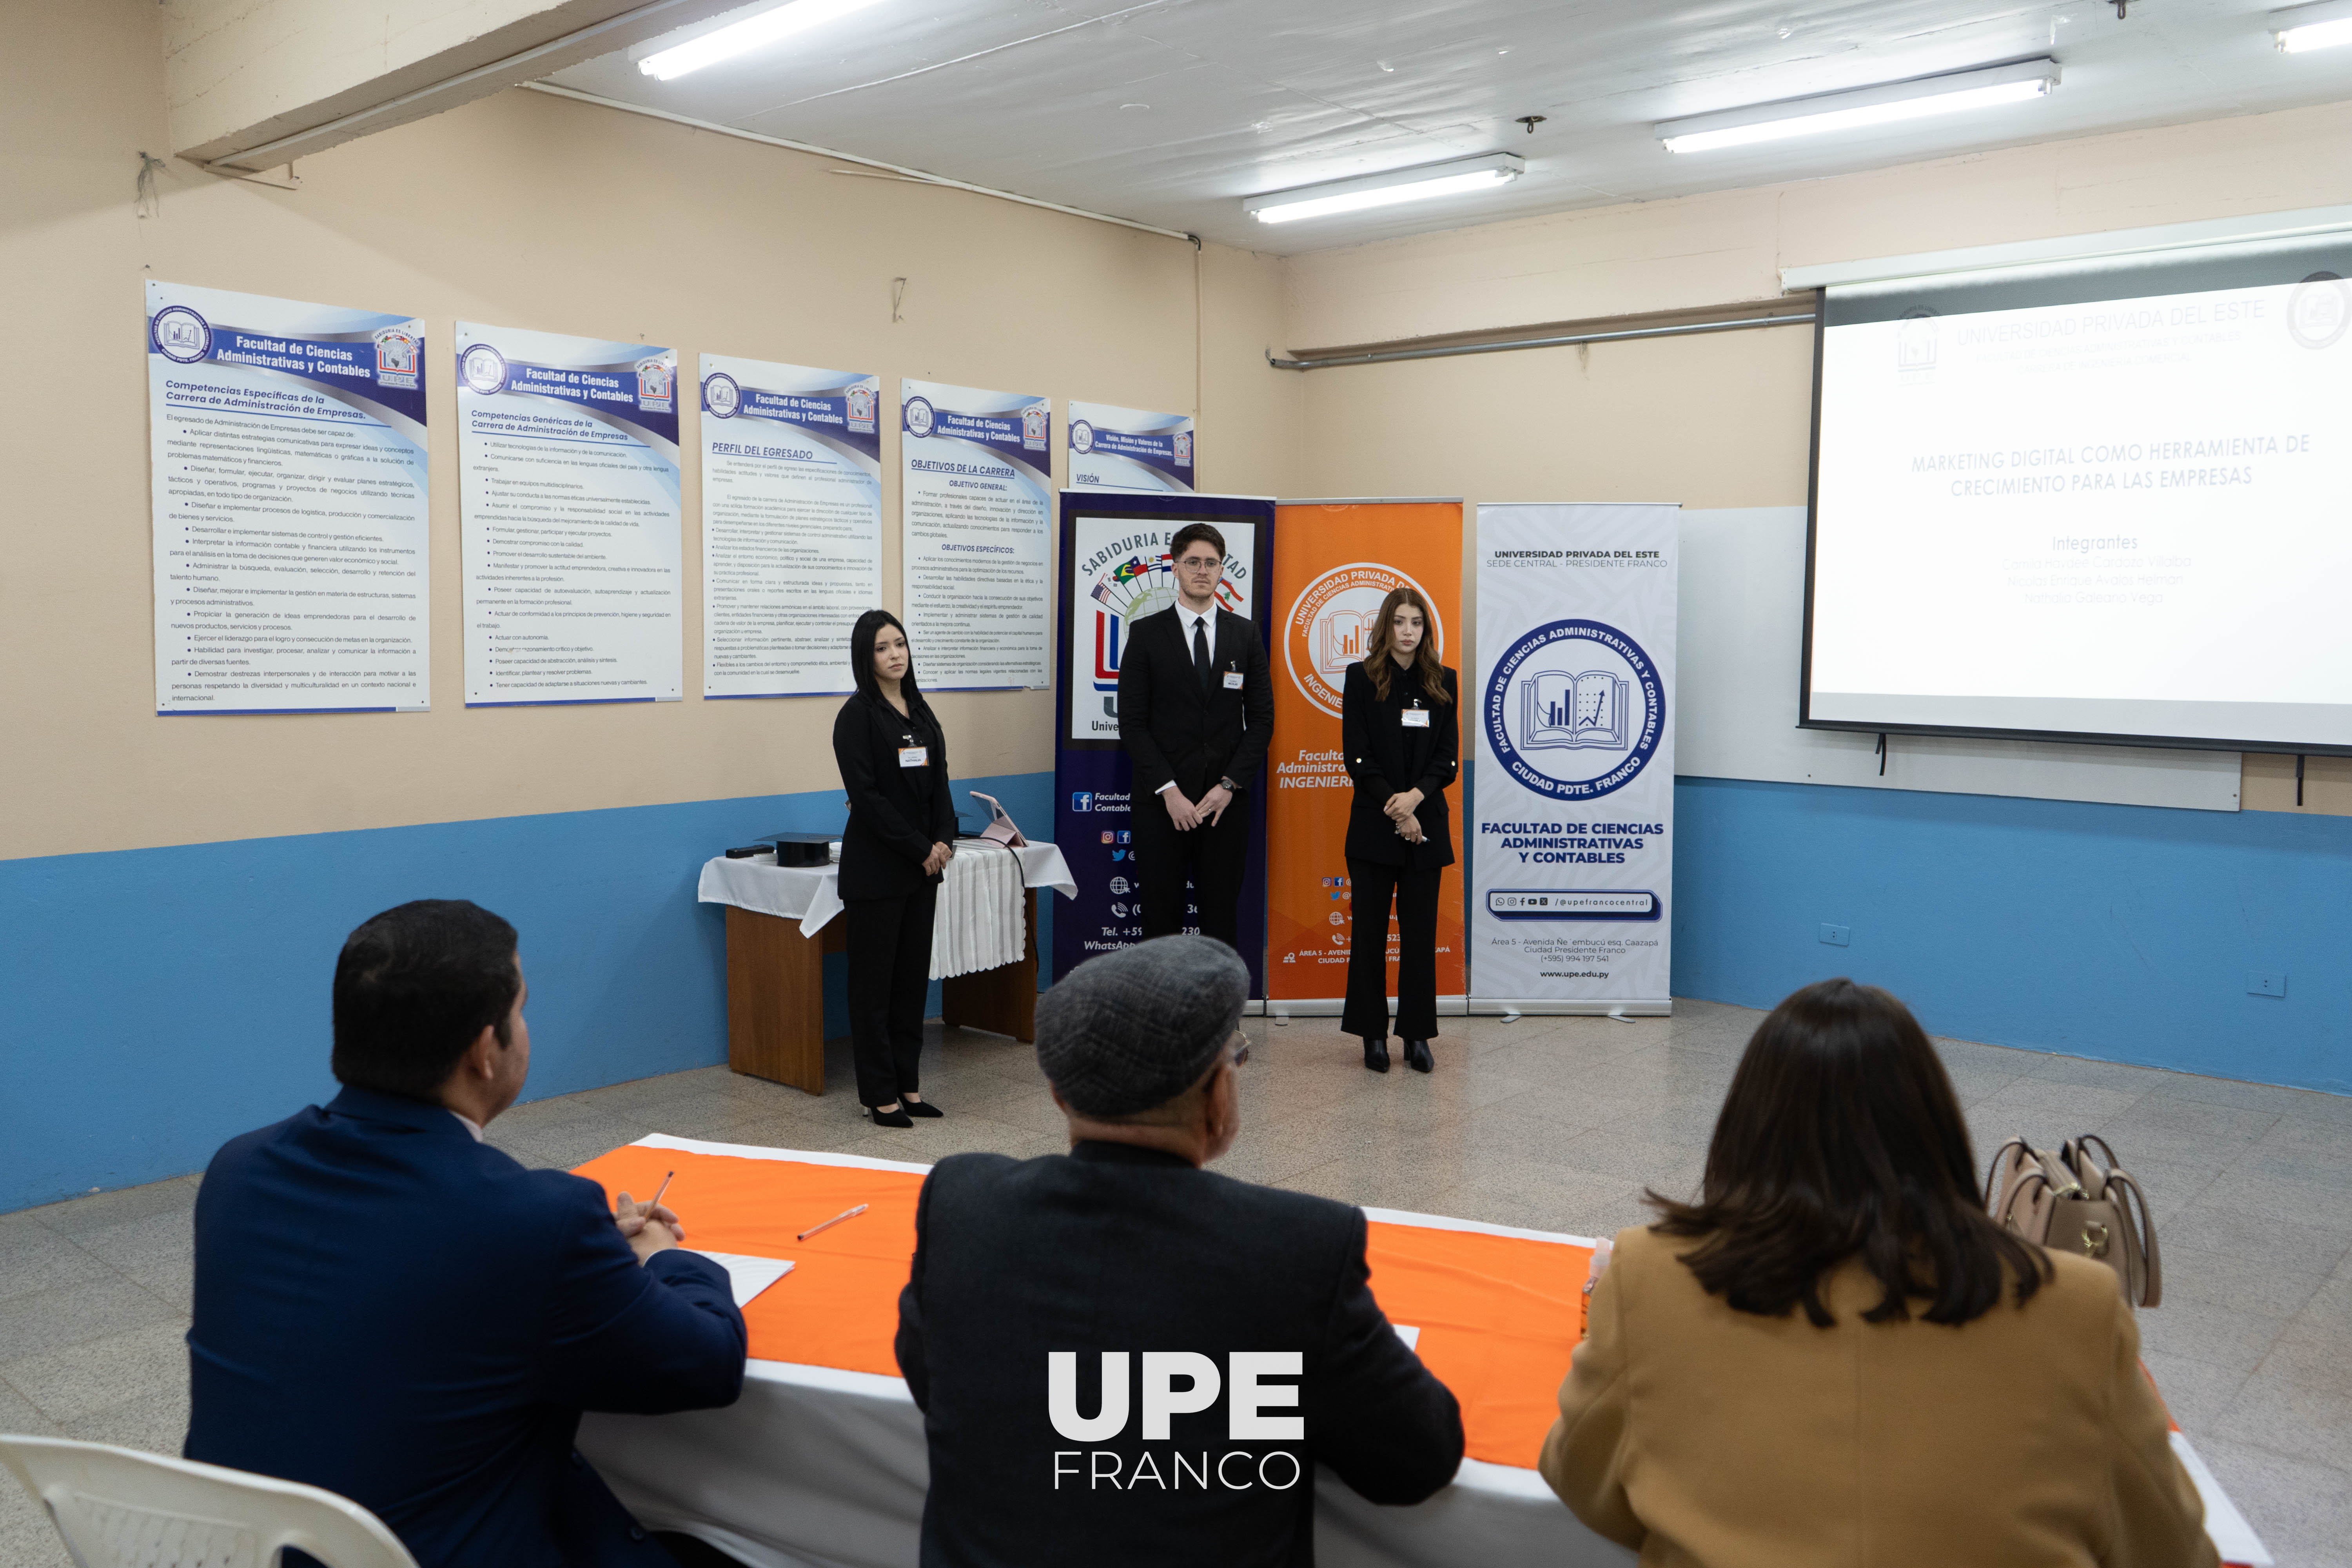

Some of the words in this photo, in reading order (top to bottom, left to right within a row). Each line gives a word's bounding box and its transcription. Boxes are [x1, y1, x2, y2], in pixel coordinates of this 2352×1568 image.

[237, 336, 285, 353] Facultad
[289, 343, 303, 354] de
[306, 345, 352, 361] Ciencias
[217, 348, 305, 370] Administrativas
[308, 362, 314, 373] y
[317, 361, 370, 377] Contables
[526, 368, 565, 382] Facultad
[568, 373, 579, 383] de
[582, 374, 619, 388] Ciencias
[166, 380, 241, 395] Competencias
[244, 389, 299, 401] Específicas
[512, 380, 581, 396] Administrativas
[583, 390, 588, 399] y
[590, 388, 633, 402] Contables
[166, 392, 206, 403] Carrera
[224, 395, 300, 412] Administración
[303, 404, 315, 414] de
[317, 408, 365, 419] Empresas.
[756, 394, 788, 406] Facultad
[790, 398, 799, 407] de
[800, 399, 831, 411] Ciencias
[472, 410, 530, 422] Competencias
[533, 416, 572, 426] Genéricas
[744, 405, 800, 419] Administrativas
[802, 413, 806, 422] y
[808, 412, 843, 424] Contables
[948, 416, 975, 426] Facultad
[976, 419, 984, 427] de
[985, 419, 1011, 430] Ciencias
[214, 419, 260, 429] Administración
[270, 424, 301, 433] Empresas
[472, 420, 503, 429] Carrera
[517, 425, 578, 436] Administración
[591, 431, 628, 440] Empresas
[938, 426, 984, 437] Administrativas
[991, 431, 1020, 442] Contables
[1106, 434, 1120, 443] Visión,
[712, 442, 742, 453] PERFIL
[744, 445, 760, 455] DEL
[763, 447, 813, 459] EGRESADO
[1118, 445, 1147, 453] Administración
[1911, 451, 2005, 473] MARKETING
[2010, 448, 2075, 468] DIGITAL
[2081, 443, 2143, 463] COMO
[2149, 436, 2278, 461] HERRAMIENTA
[2286, 434, 2311, 453] DE
[911, 459, 955, 471] OBJETIVOS
[957, 464, 967, 472] DE
[968, 465, 977, 474] LA
[980, 466, 1015, 477] CARRERA
[949, 480, 978, 488] OBJETIVO
[1076, 473, 1099, 483] VISIÓN
[1950, 475, 2066, 497] CRECIMIENTO
[2071, 472, 2116, 492] PARA
[2122, 471, 2154, 489] LAS
[2160, 466, 2252, 488] EMPRESAS
[976, 545, 1014, 554] ESPECÍFICOS:
[1082, 532, 1158, 576] SABIDURIA
[2052, 535, 2138, 554] Integrantes
[1295, 573, 1348, 625] UNIVERSIDAD
[1351, 571, 1395, 585] PRIVADA
[1302, 607, 1317, 637] FACULTAD
[1323, 583, 1349, 600] CIENCIAS
[1350, 581, 1394, 592] ADMINISTRATI
[1503, 634, 1546, 675] CIENCIAS
[1549, 627, 1644, 670] ADMINISTRATIVAS
[1304, 674, 1343, 708] INGENIE
[1495, 676, 1506, 692] DE
[1492, 696, 1510, 753] FACULTAD
[1640, 682, 1657, 750] CONTABLES
[1299, 750, 1343, 761] Faculta
[1276, 762, 1346, 773] Administra
[1512, 761, 1554, 791] CIUDAD
[1557, 783, 1593, 794] PDTE.
[1595, 756, 1641, 791] FRANCO
[1482, 823, 1562, 834] FACULTAD
[1567, 823, 1587, 834] DE
[1592, 823, 1664, 835] CIENCIAS
[1501, 838, 1643, 849] ADMINISTRATIVAS
[1519, 852, 1529, 863] Y
[1533, 852, 1625, 863] CONTABLES
[1102, 927, 1118, 935] Tel.
